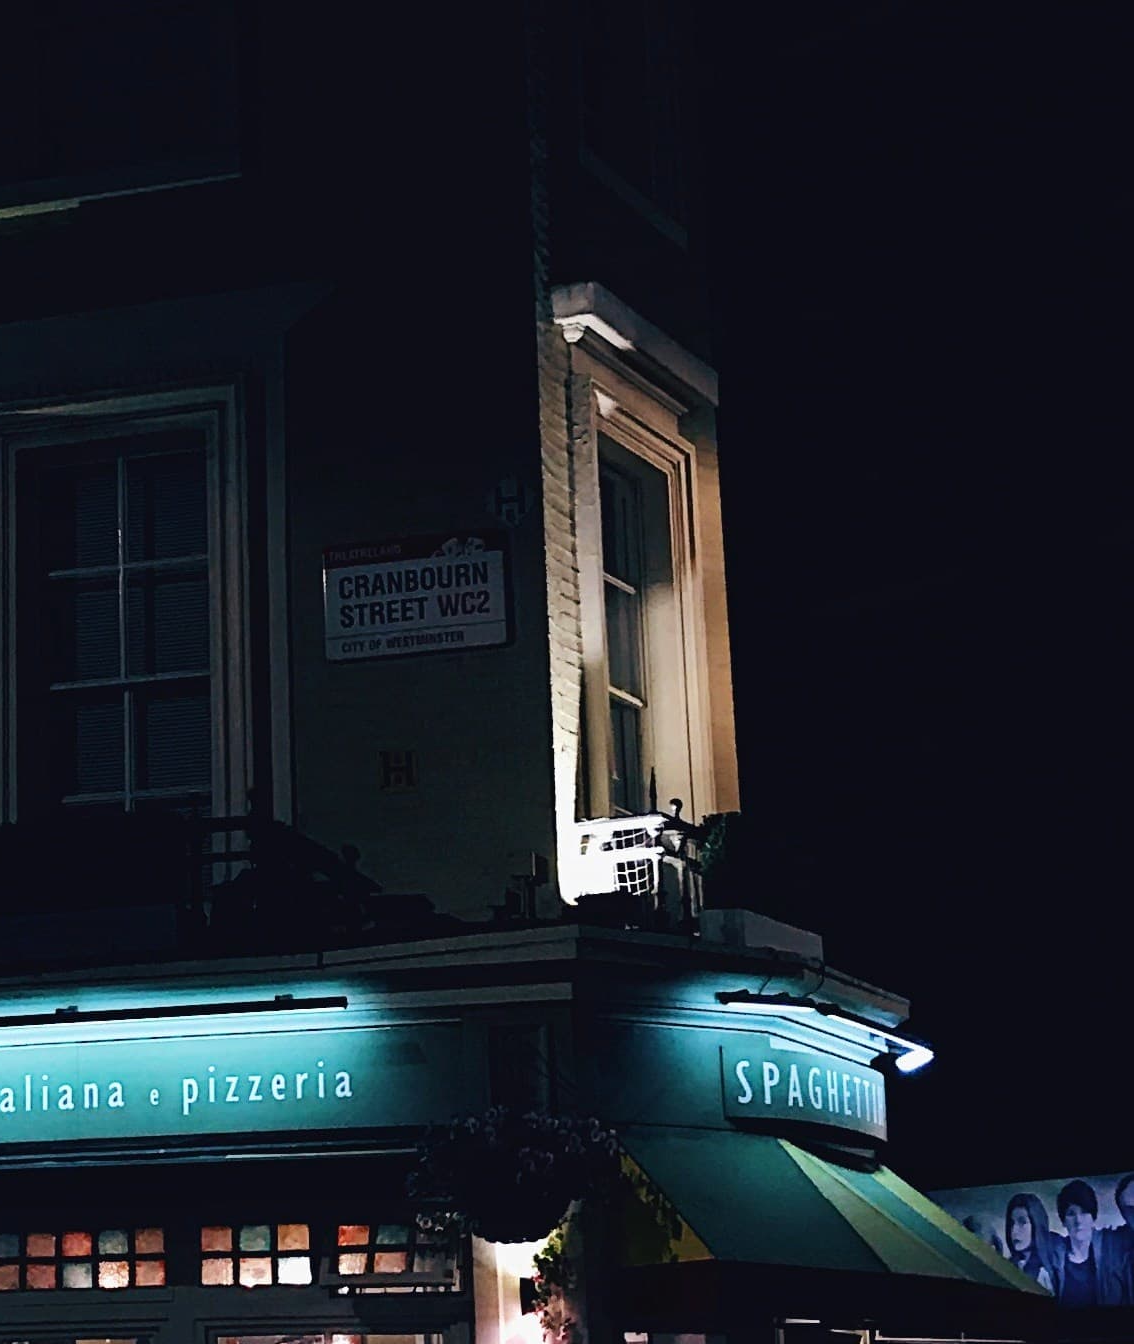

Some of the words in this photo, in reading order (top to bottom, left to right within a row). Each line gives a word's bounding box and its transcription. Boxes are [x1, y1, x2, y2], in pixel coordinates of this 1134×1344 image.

[338, 561, 489, 599] CRANBOURN
[340, 597, 428, 628] STREET
[437, 590, 490, 617] WC2
[341, 639, 366, 654] CITY
[369, 637, 382, 650] OF
[385, 630, 465, 649] WESTMINSTER
[149, 1088, 160, 1106] e
[182, 1060, 353, 1116] pizzeria
[735, 1060, 878, 1126] SPAGHETTI
